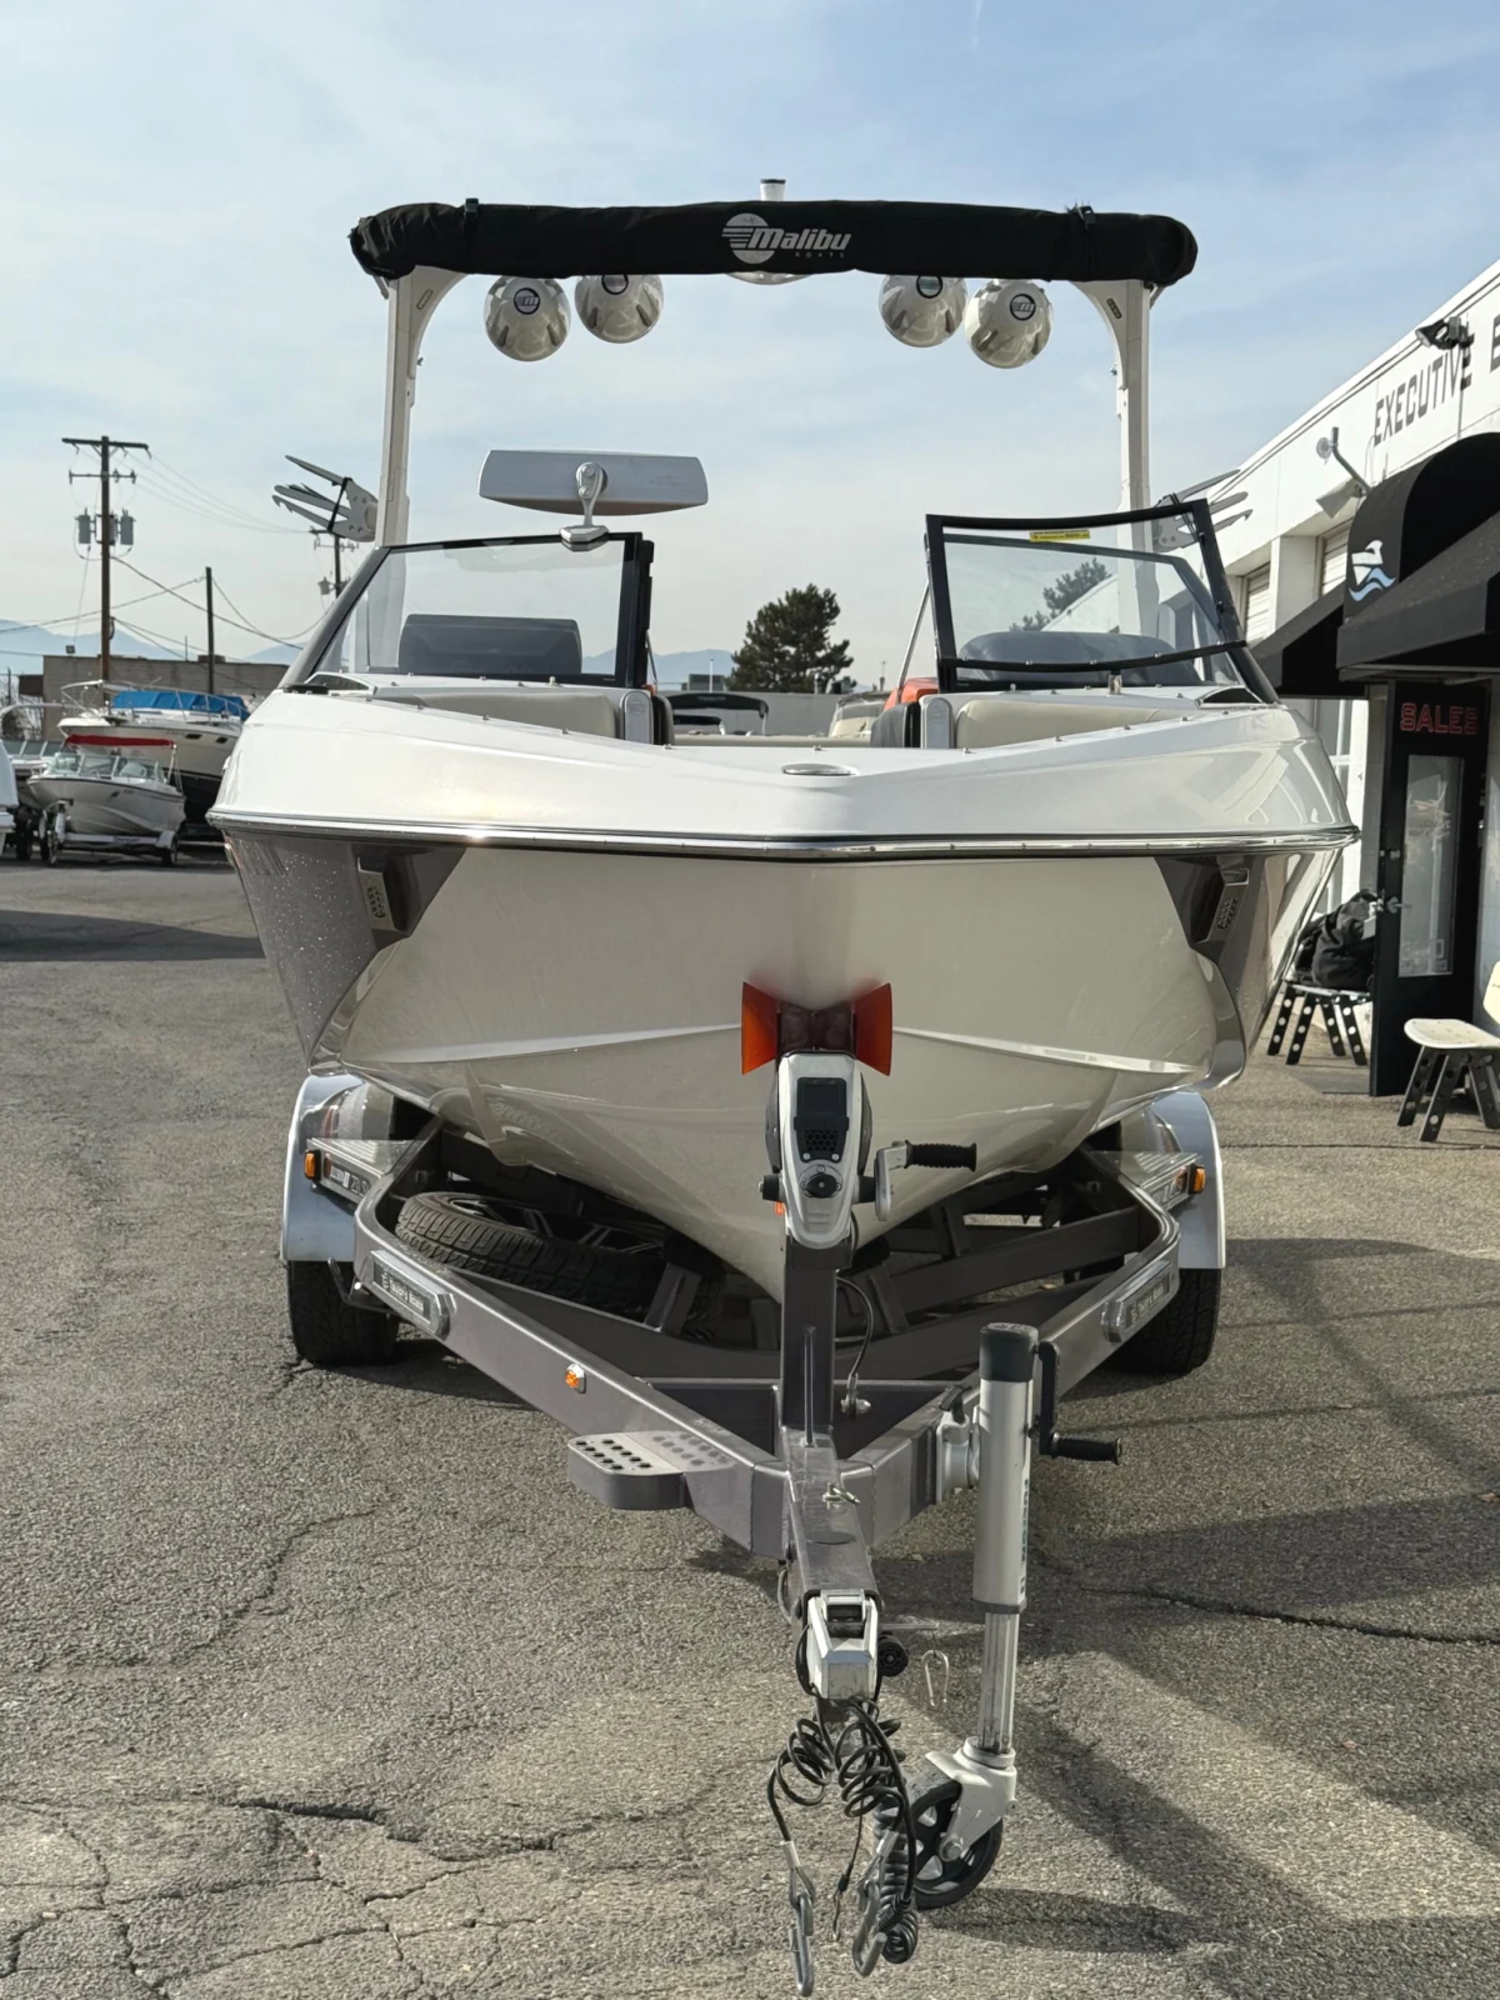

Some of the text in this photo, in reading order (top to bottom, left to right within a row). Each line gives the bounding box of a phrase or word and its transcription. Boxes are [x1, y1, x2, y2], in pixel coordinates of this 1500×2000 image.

[747, 227, 852, 250] Malibu
[1374, 333, 1475, 447] EXECUTIVE
[1400, 702, 1478, 735] SALES
